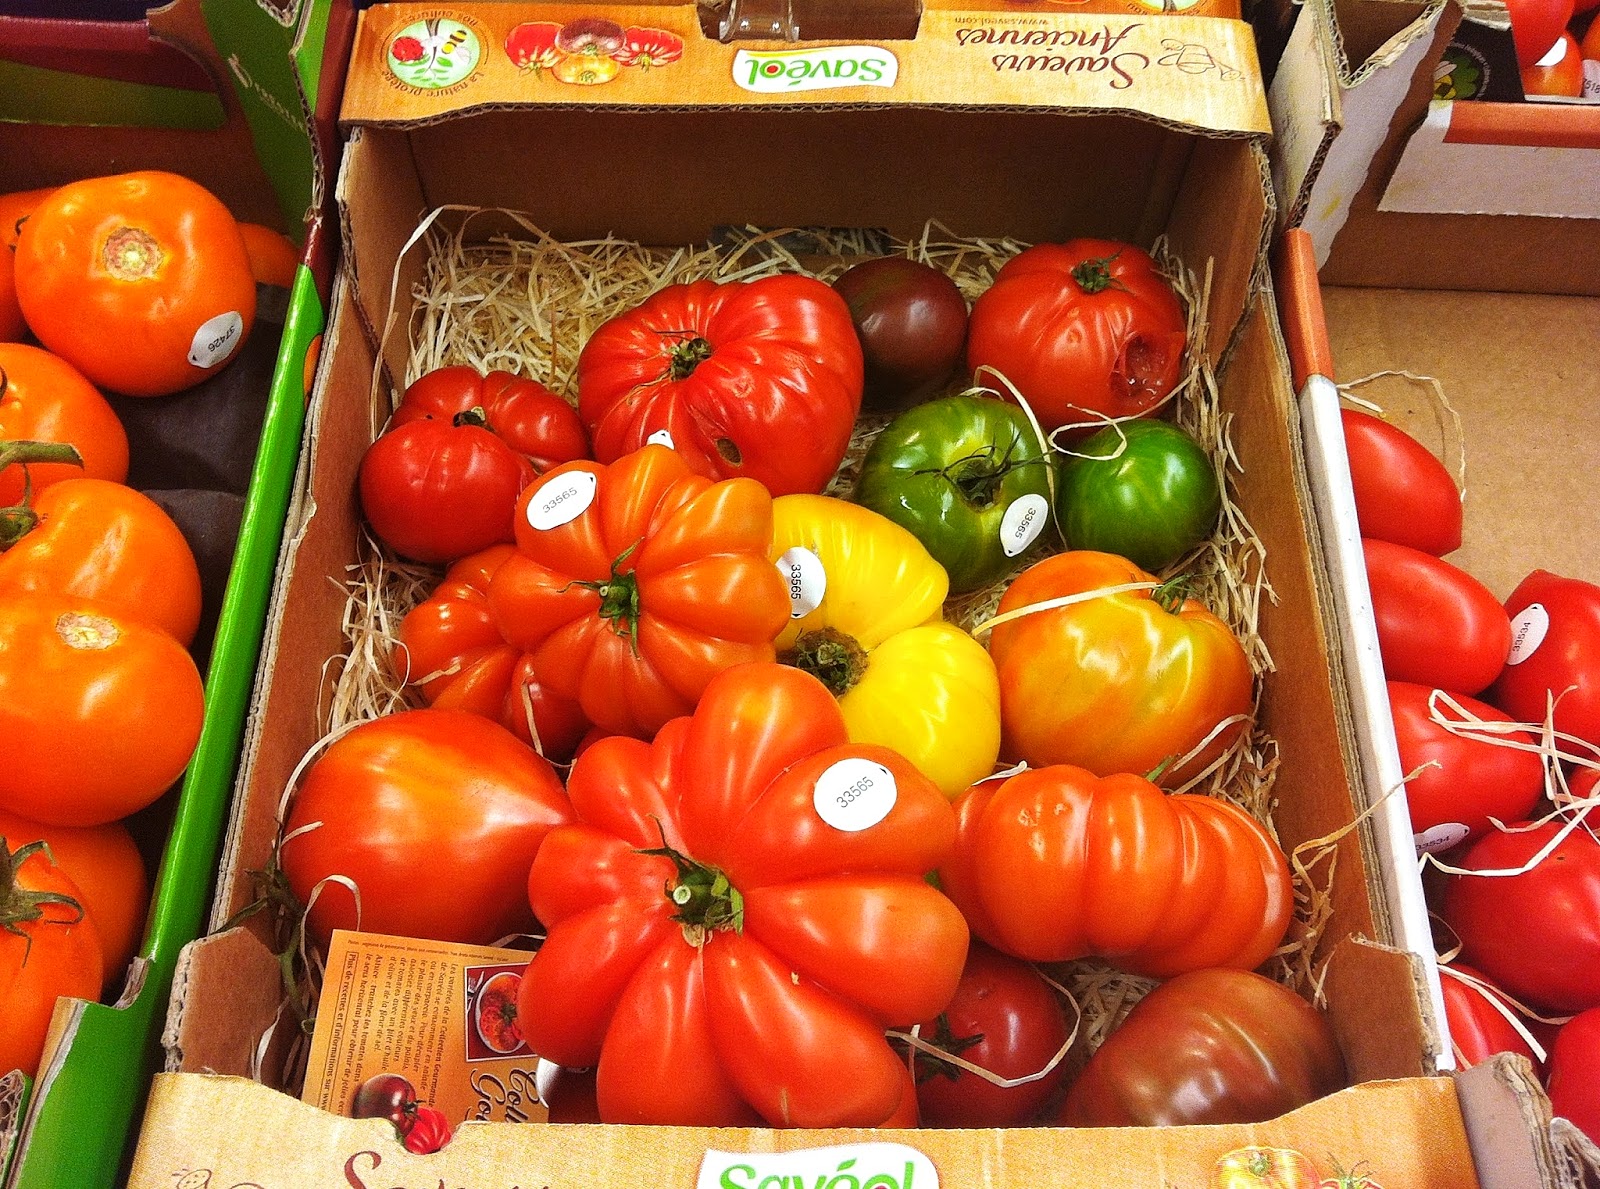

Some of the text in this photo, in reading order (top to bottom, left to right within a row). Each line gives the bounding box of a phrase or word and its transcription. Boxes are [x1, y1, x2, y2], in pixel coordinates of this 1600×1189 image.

[955, 23, 1144, 55] Anciennes
[744, 58, 887, 86] Savéol
[992, 52, 1150, 90] Saveurs
[380, 71, 485, 98] La nature protège
[207, 325, 235, 352] 37426
[542, 487, 578, 514] 33565
[1014, 507, 1037, 539] 33565
[790, 564, 802, 600] 33565
[1512, 622, 1532, 652] 33534
[836, 776, 874, 808] 33565
[347, 954, 356, 969] Plus
[399, 957, 407, 966] de
[430, 961, 437, 970] ou
[440, 962, 448, 971] de
[345, 971, 353, 980] de
[394, 968, 405, 996] tomates
[428, 972, 435, 981] en
[339, 982, 350, 1011] recettes
[355, 980, 368, 1018] horizontal
[365, 985, 377, 1018] tranchez
[383, 990, 391, 999] de
[414, 993, 422, 1005] des
[363, 1019, 371, 1029] les
[389, 1017, 395, 1027] un
[443, 1006, 451, 1016] de
[350, 1019, 360, 1038] pour
[376, 1029, 384, 1039] de
[346, 1039, 357, 1067] obtenir
[357, 1031, 368, 1061] tomates
[393, 1030, 405, 1062] couleurs
[425, 1055, 431, 1063] en
[324, 1079, 332, 1090] sur
[343, 1068, 352, 1078] de
[353, 1063, 363, 1083] dans
[420, 1065, 430, 1091] salade
[428, 1064, 441, 1108] Gourmande
